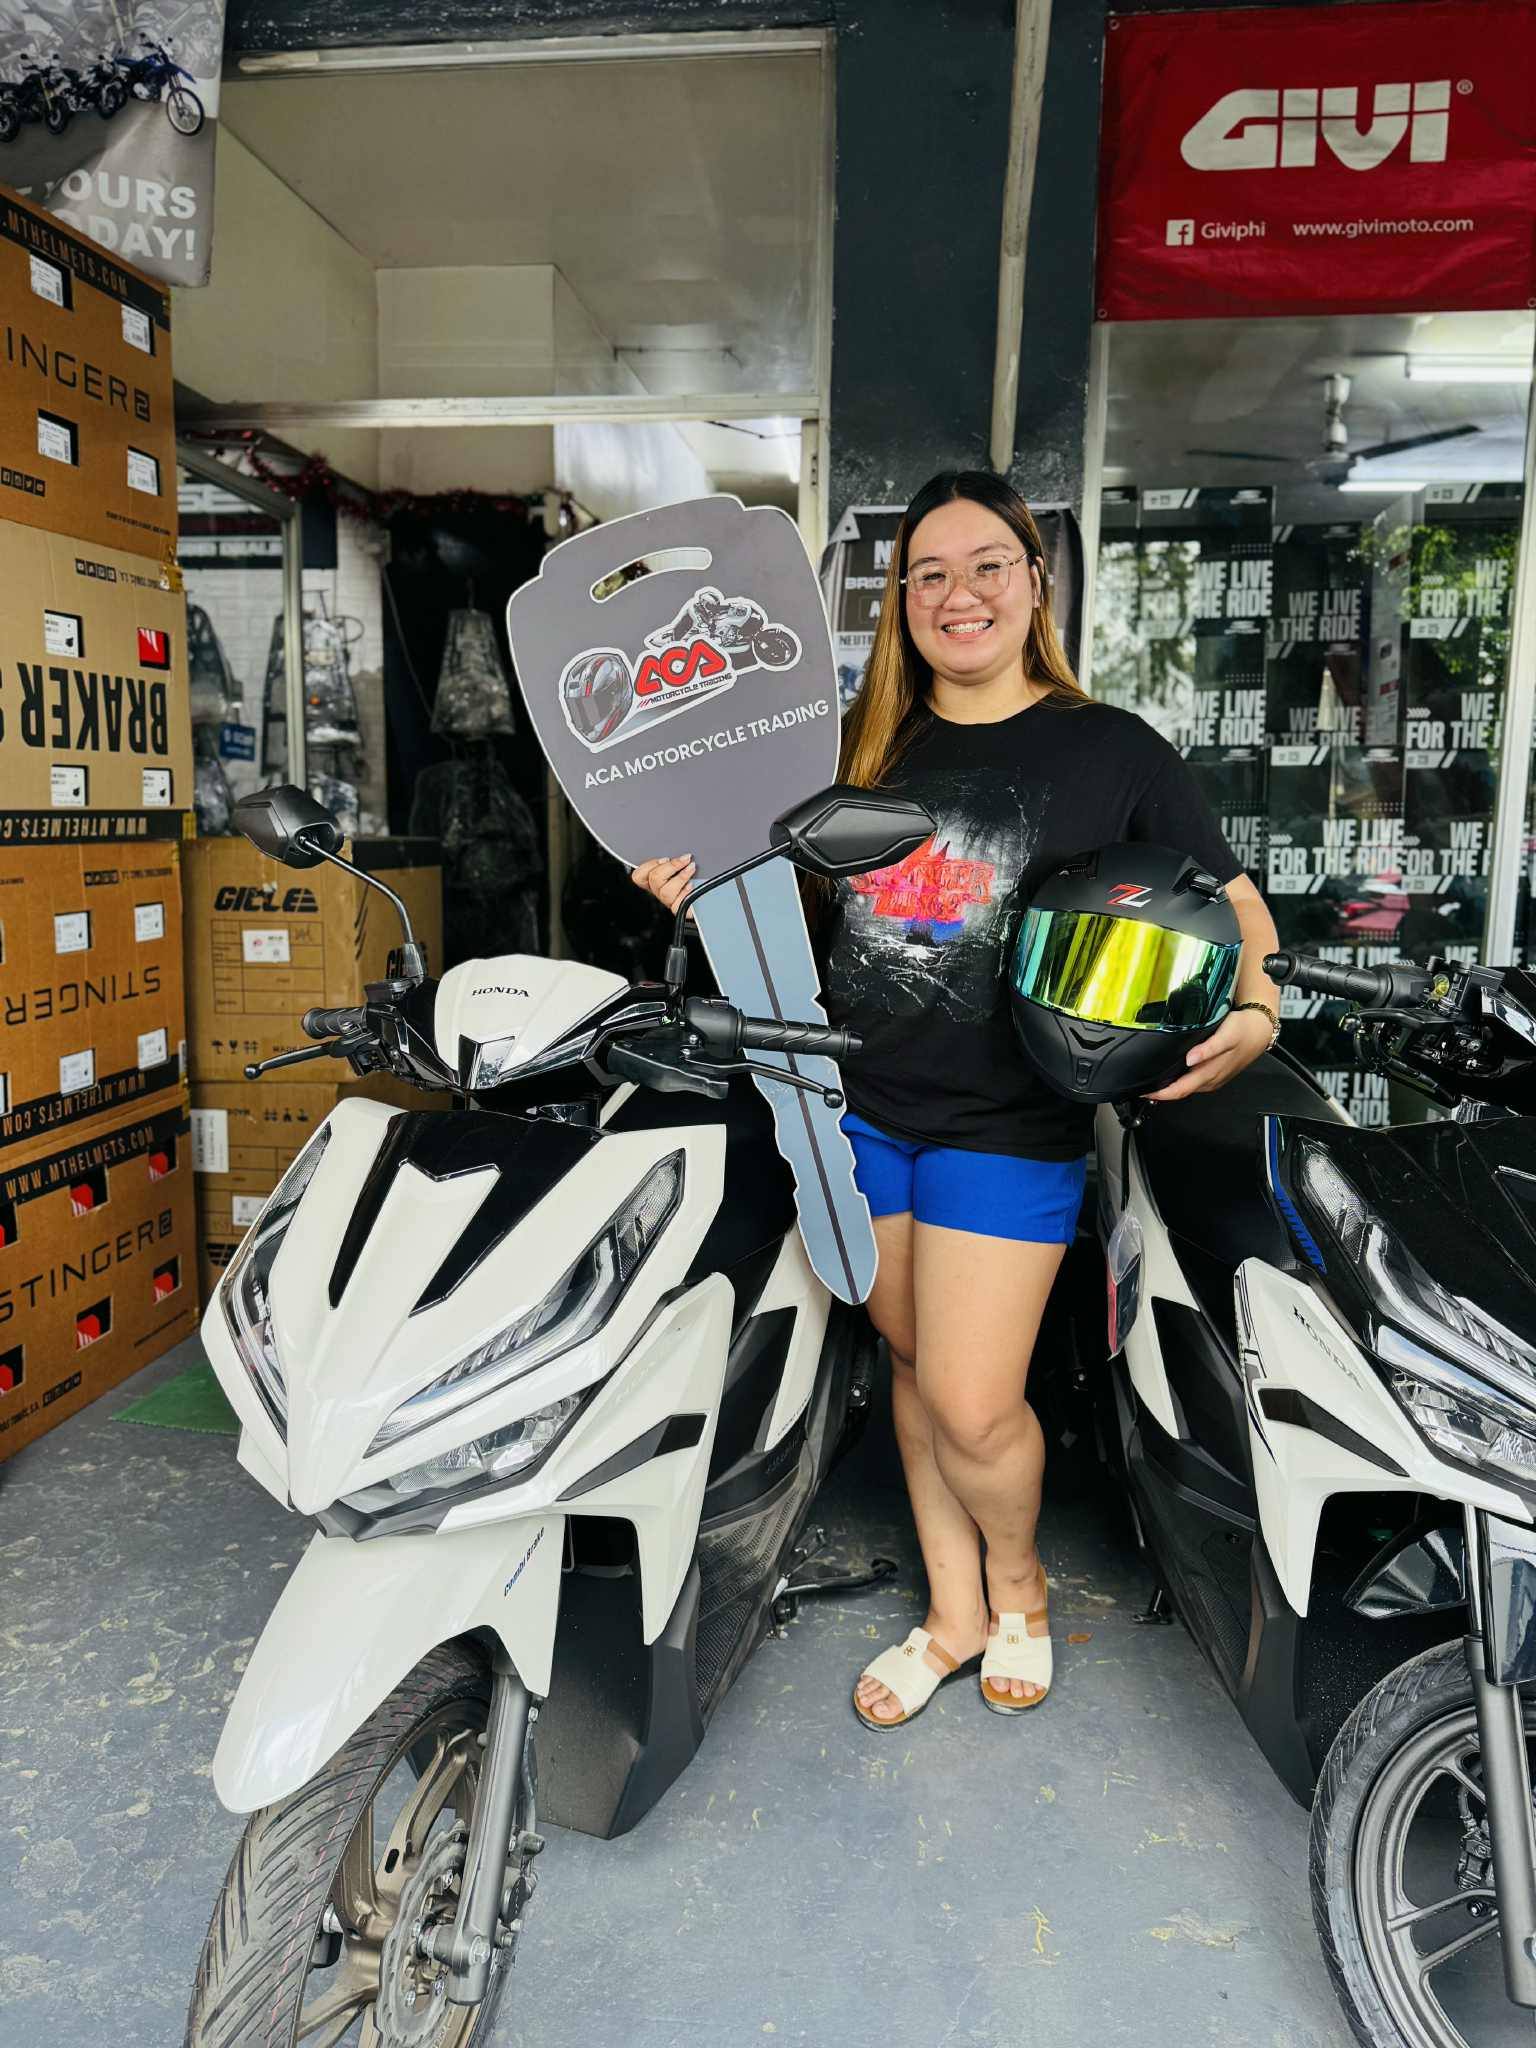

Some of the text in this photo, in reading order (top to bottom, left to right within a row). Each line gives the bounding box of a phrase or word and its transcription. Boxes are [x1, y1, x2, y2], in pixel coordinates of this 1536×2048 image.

[1180, 80, 1451, 171] GIVI
[1200, 220, 1266, 240] Giviphi
[1292, 216, 1475, 239] www.givimoto.com
[3, 208, 129, 297] .MTHELMETS.COM
[844, 576, 888, 591] BRIG
[1230, 560, 1274, 589] LIVE
[1475, 559, 1509, 588] WE
[1225, 589, 1273, 618] RIDE
[1288, 589, 1362, 617] WE LIVE
[1420, 588, 1502, 618] FOR THE
[1280, 617, 1315, 642] THE
[1318, 615, 1361, 641] RIDE
[17, 662, 169, 755] BRAKER
[1224, 689, 1267, 718] LIVE
[1461, 692, 1495, 721] WE
[1219, 718, 1265, 746] RIDE
[1288, 707, 1318, 732] WE
[584, 699, 830, 789] ACA MOTORCYCLE TRADING
[1406, 720, 1489, 749] FOR THE
[0, 816, 147, 838] WWW.MTHELMETS.C
[1221, 815, 1262, 843] LIVE
[1323, 818, 1406, 848] WE LIVE
[1450, 821, 1484, 849] WE
[1268, 846, 1404, 876] FOR THE RIDE
[1439, 848, 1478, 877] THE
[5, 966, 161, 1026] STINGER
[472, 986, 530, 998] HONDA
[1315, 1071, 1349, 1099] WE
